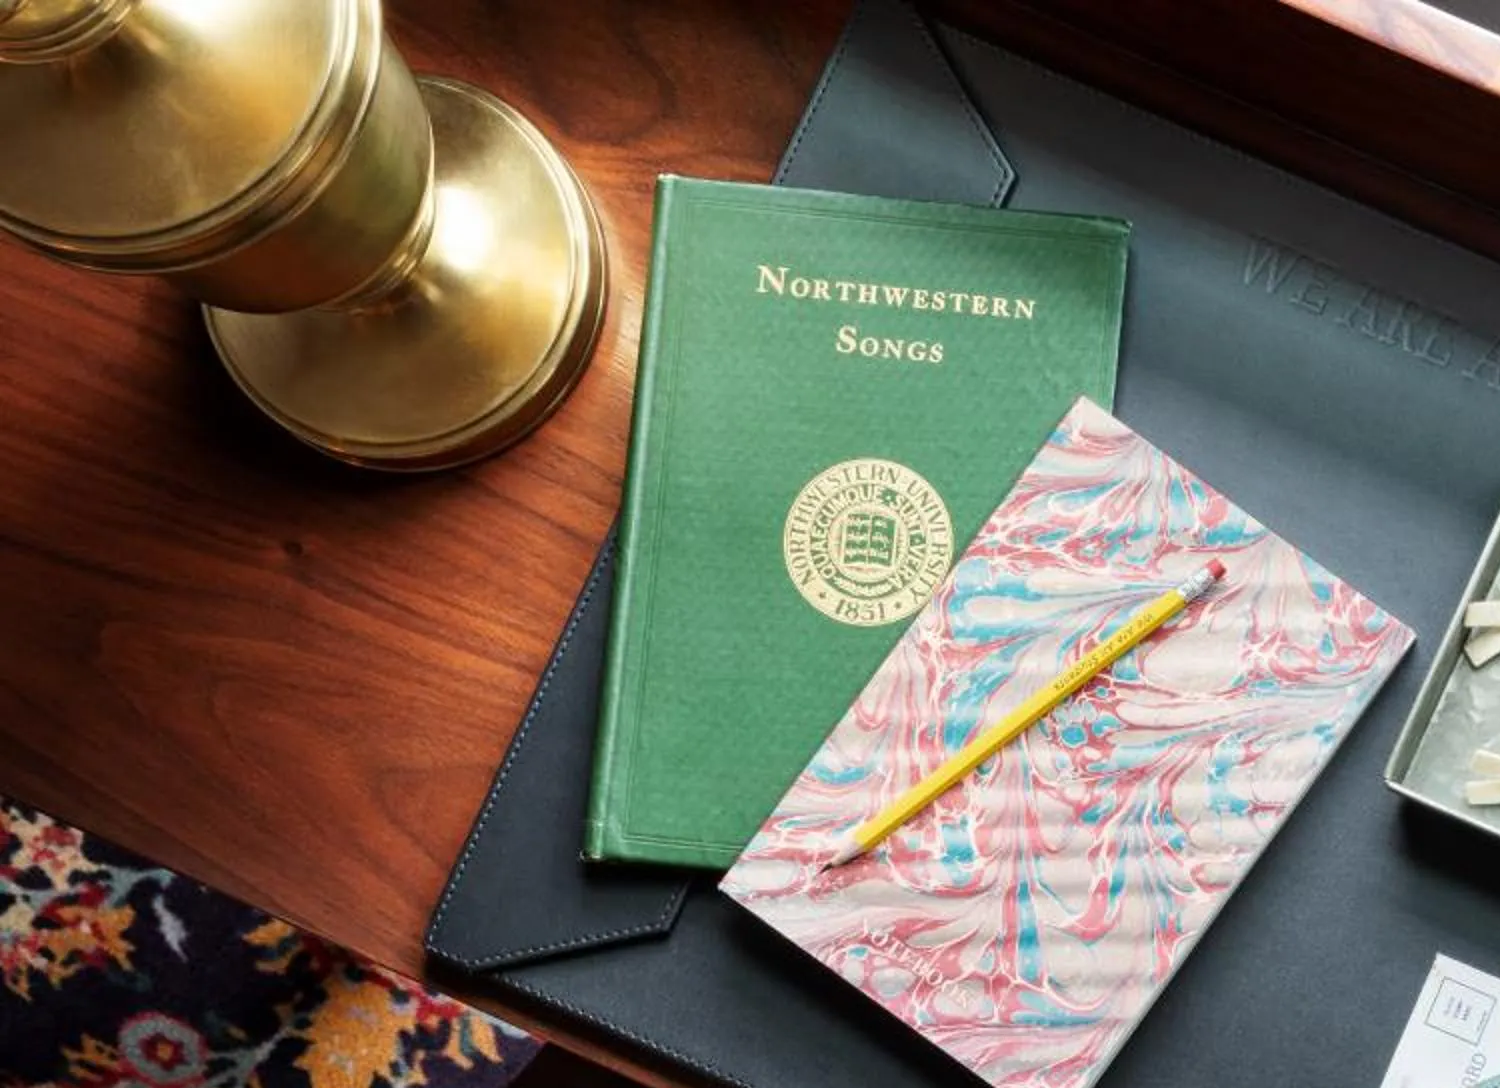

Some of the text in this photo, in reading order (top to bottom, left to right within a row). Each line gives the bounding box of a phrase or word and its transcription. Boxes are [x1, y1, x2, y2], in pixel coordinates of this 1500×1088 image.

[756, 264, 1036, 320] NORTHWESTERN
[1239, 235, 1343, 316] WE
[1336, 279, 1460, 368] ARE
[835, 324, 944, 364] SONGS
[835, 599, 885, 622] 1851
